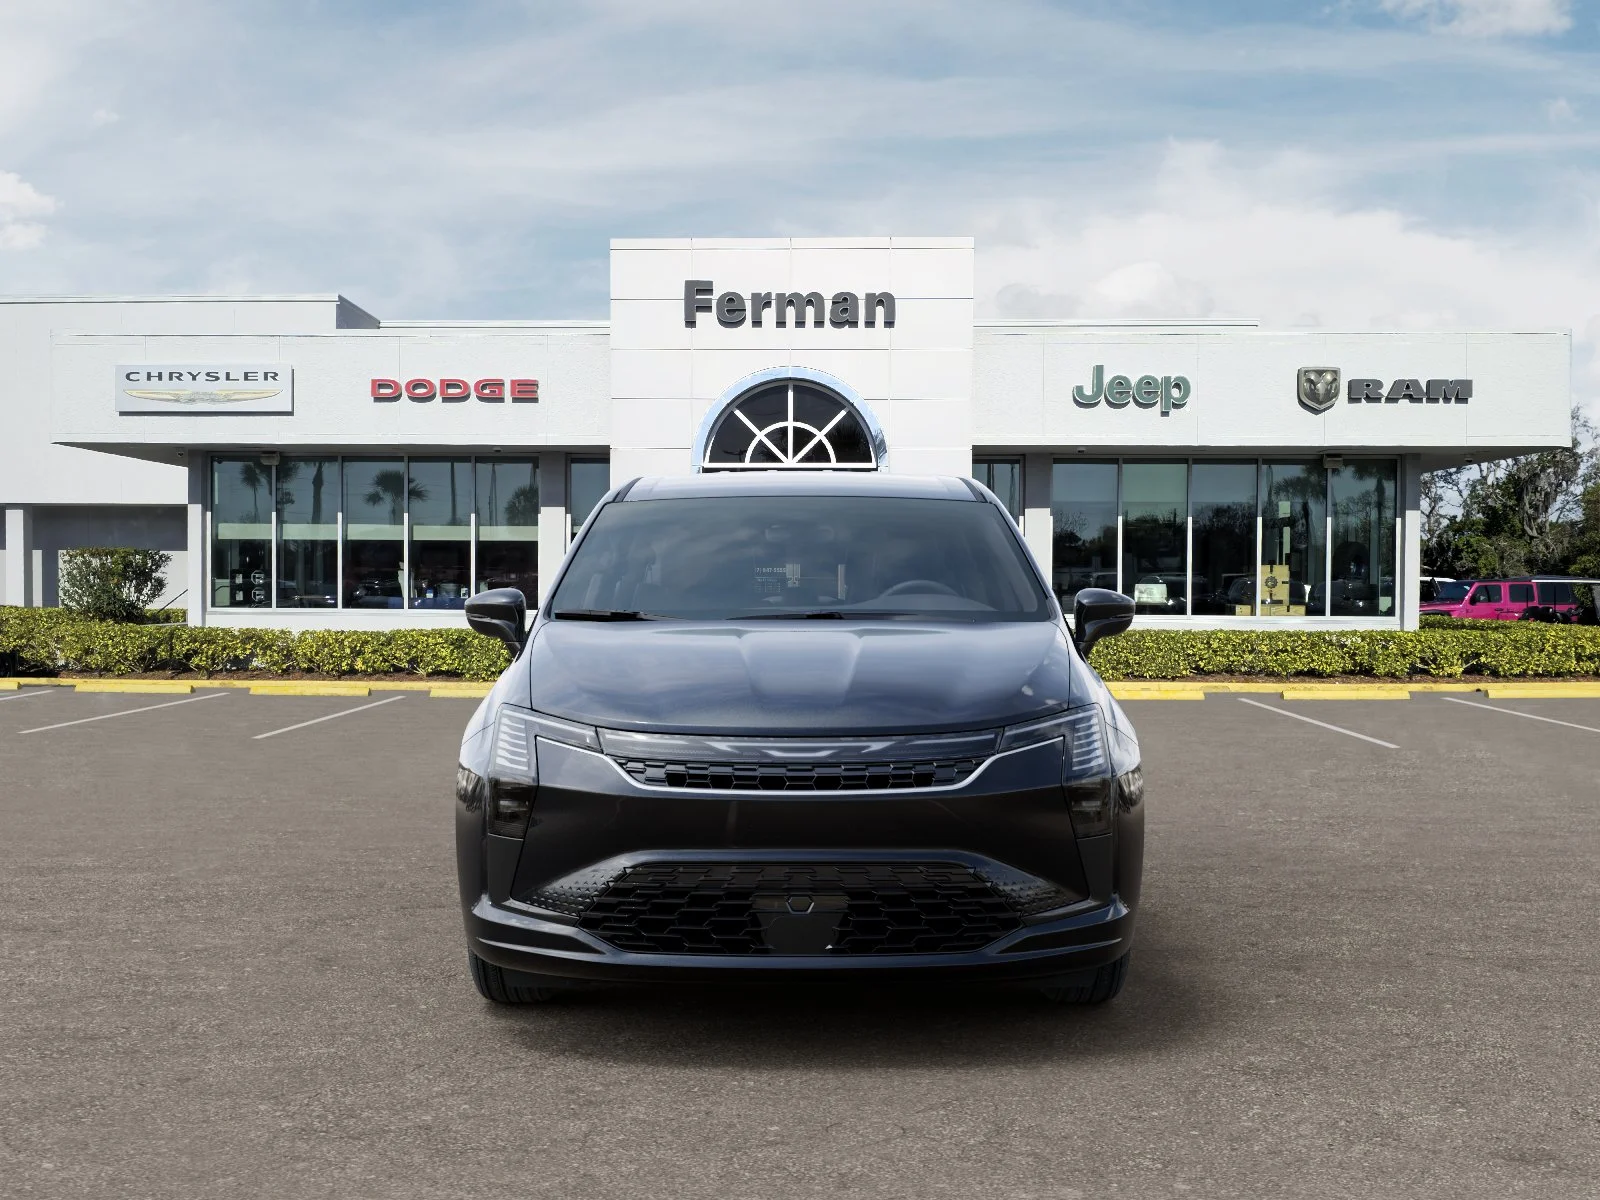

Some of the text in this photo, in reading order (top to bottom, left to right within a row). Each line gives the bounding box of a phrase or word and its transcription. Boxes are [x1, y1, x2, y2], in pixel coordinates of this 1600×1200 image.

[684, 280, 896, 328] Ferman
[125, 371, 279, 382] CHRYSLER
[371, 378, 538, 402] DODGE
[1073, 365, 1191, 415] Jeep
[1348, 379, 1473, 403] RAM
